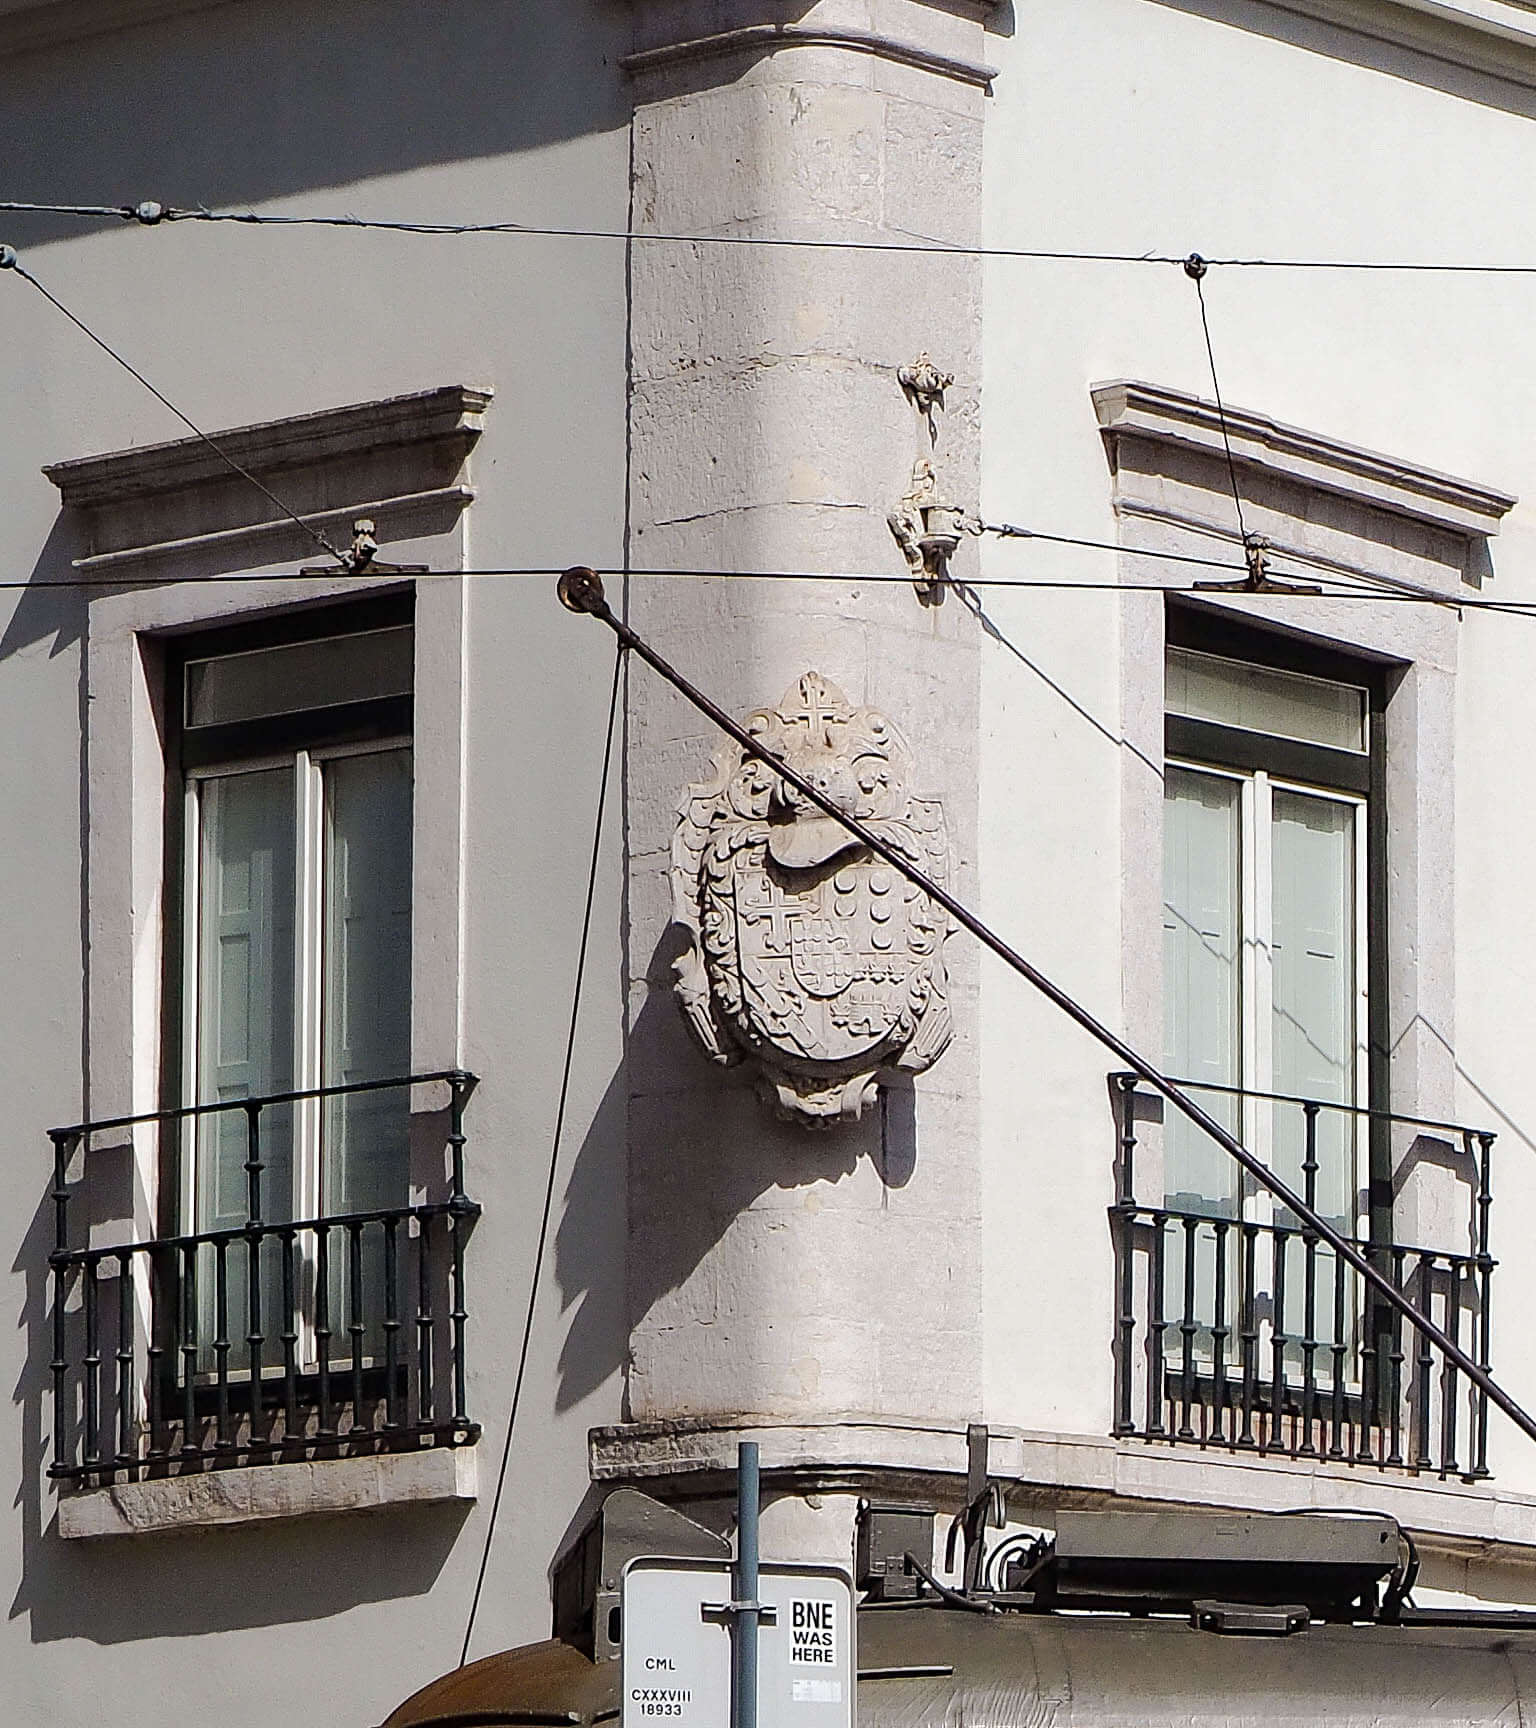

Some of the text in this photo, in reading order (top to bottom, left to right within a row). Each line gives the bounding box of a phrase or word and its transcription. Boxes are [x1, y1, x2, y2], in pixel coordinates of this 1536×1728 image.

[792, 1602, 833, 1629] BNE
[793, 1631, 833, 1646] WAS
[792, 1648, 833, 1663] HERE
[645, 1658, 676, 1671] CML
[631, 1688, 691, 1701] CXXXVIII
[640, 1703, 682, 1716] 18933
